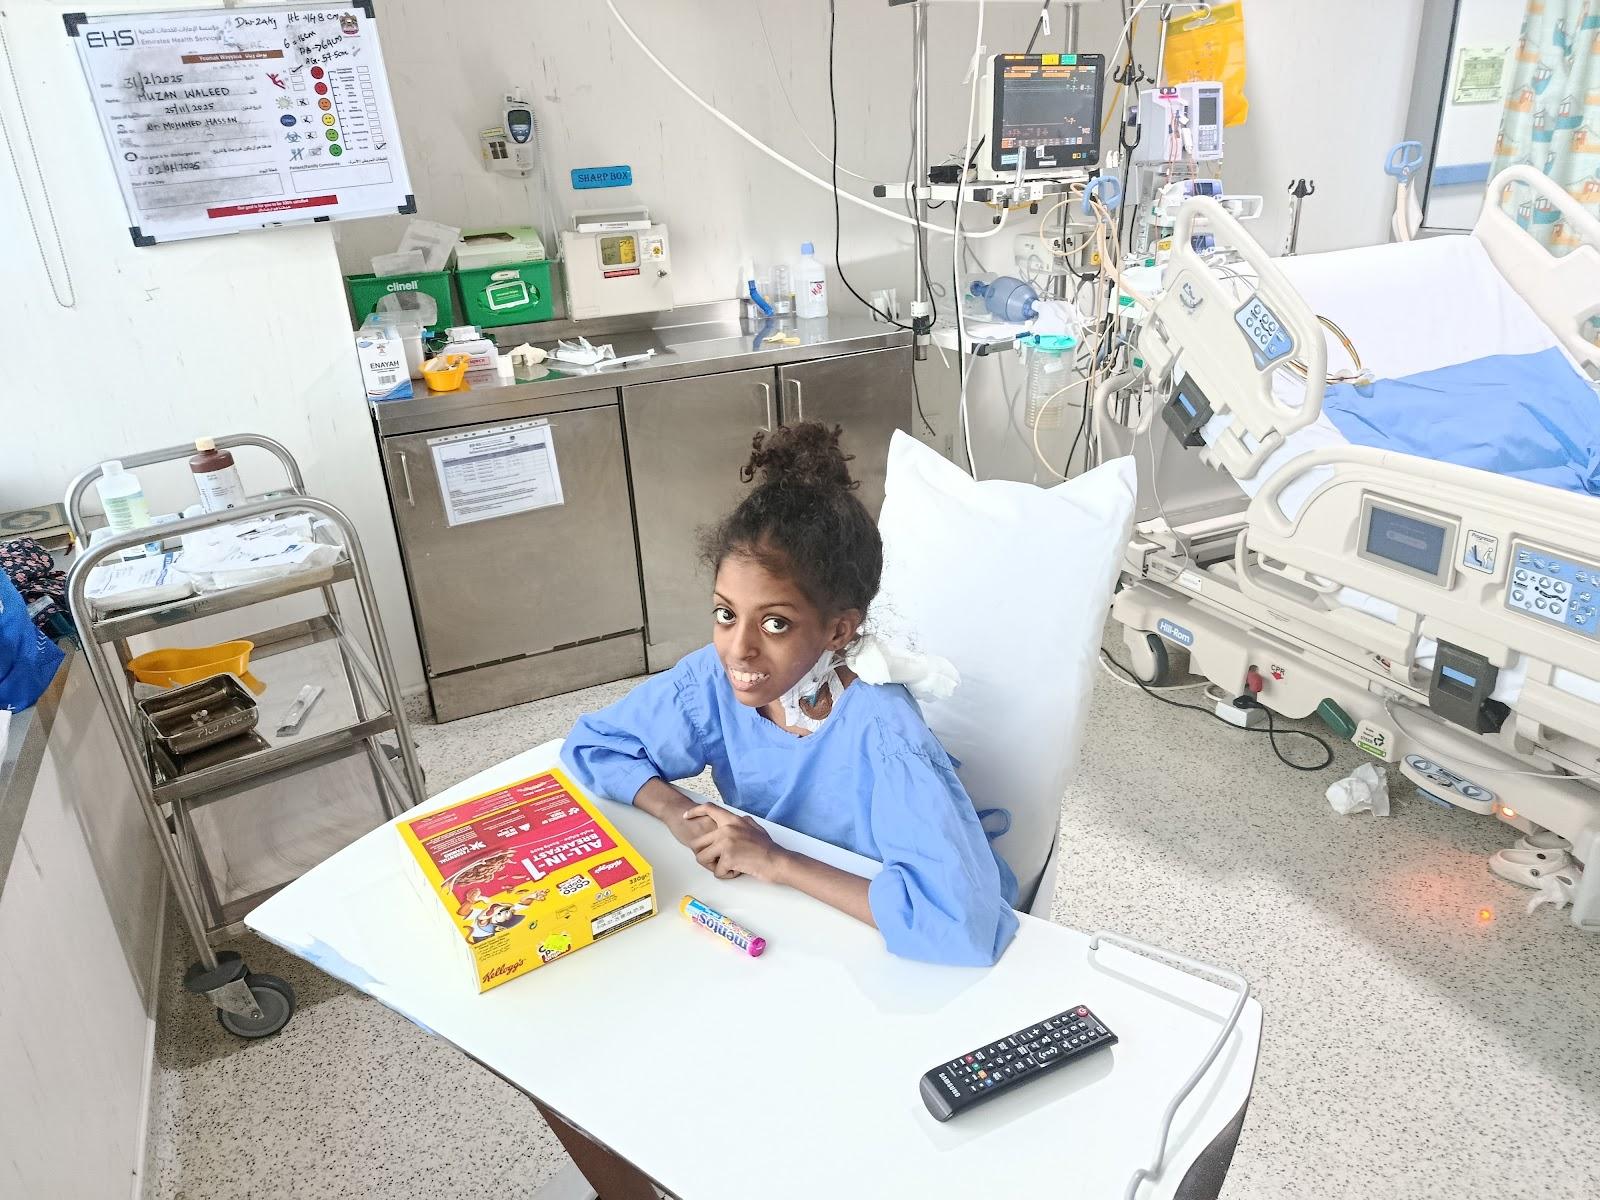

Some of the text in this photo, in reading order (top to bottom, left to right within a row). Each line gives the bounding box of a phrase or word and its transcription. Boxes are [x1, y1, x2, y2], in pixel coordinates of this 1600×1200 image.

[86, 29, 135, 48] EHS
[184, 87, 230, 98] WALEED
[578, 170, 629, 183] SHARP BOX
[386, 280, 419, 292] clinell
[370, 360, 400, 369] ENAYAH
[1159, 621, 1190, 643] Hill-Rom
[1270, 664, 1285, 676] CPR
[533, 833, 599, 862] BREAKFAST
[699, 913, 749, 950] mentos
[482, 960, 525, 984] Kellogg's
[938, 1072, 961, 1098] SAMSUNG
